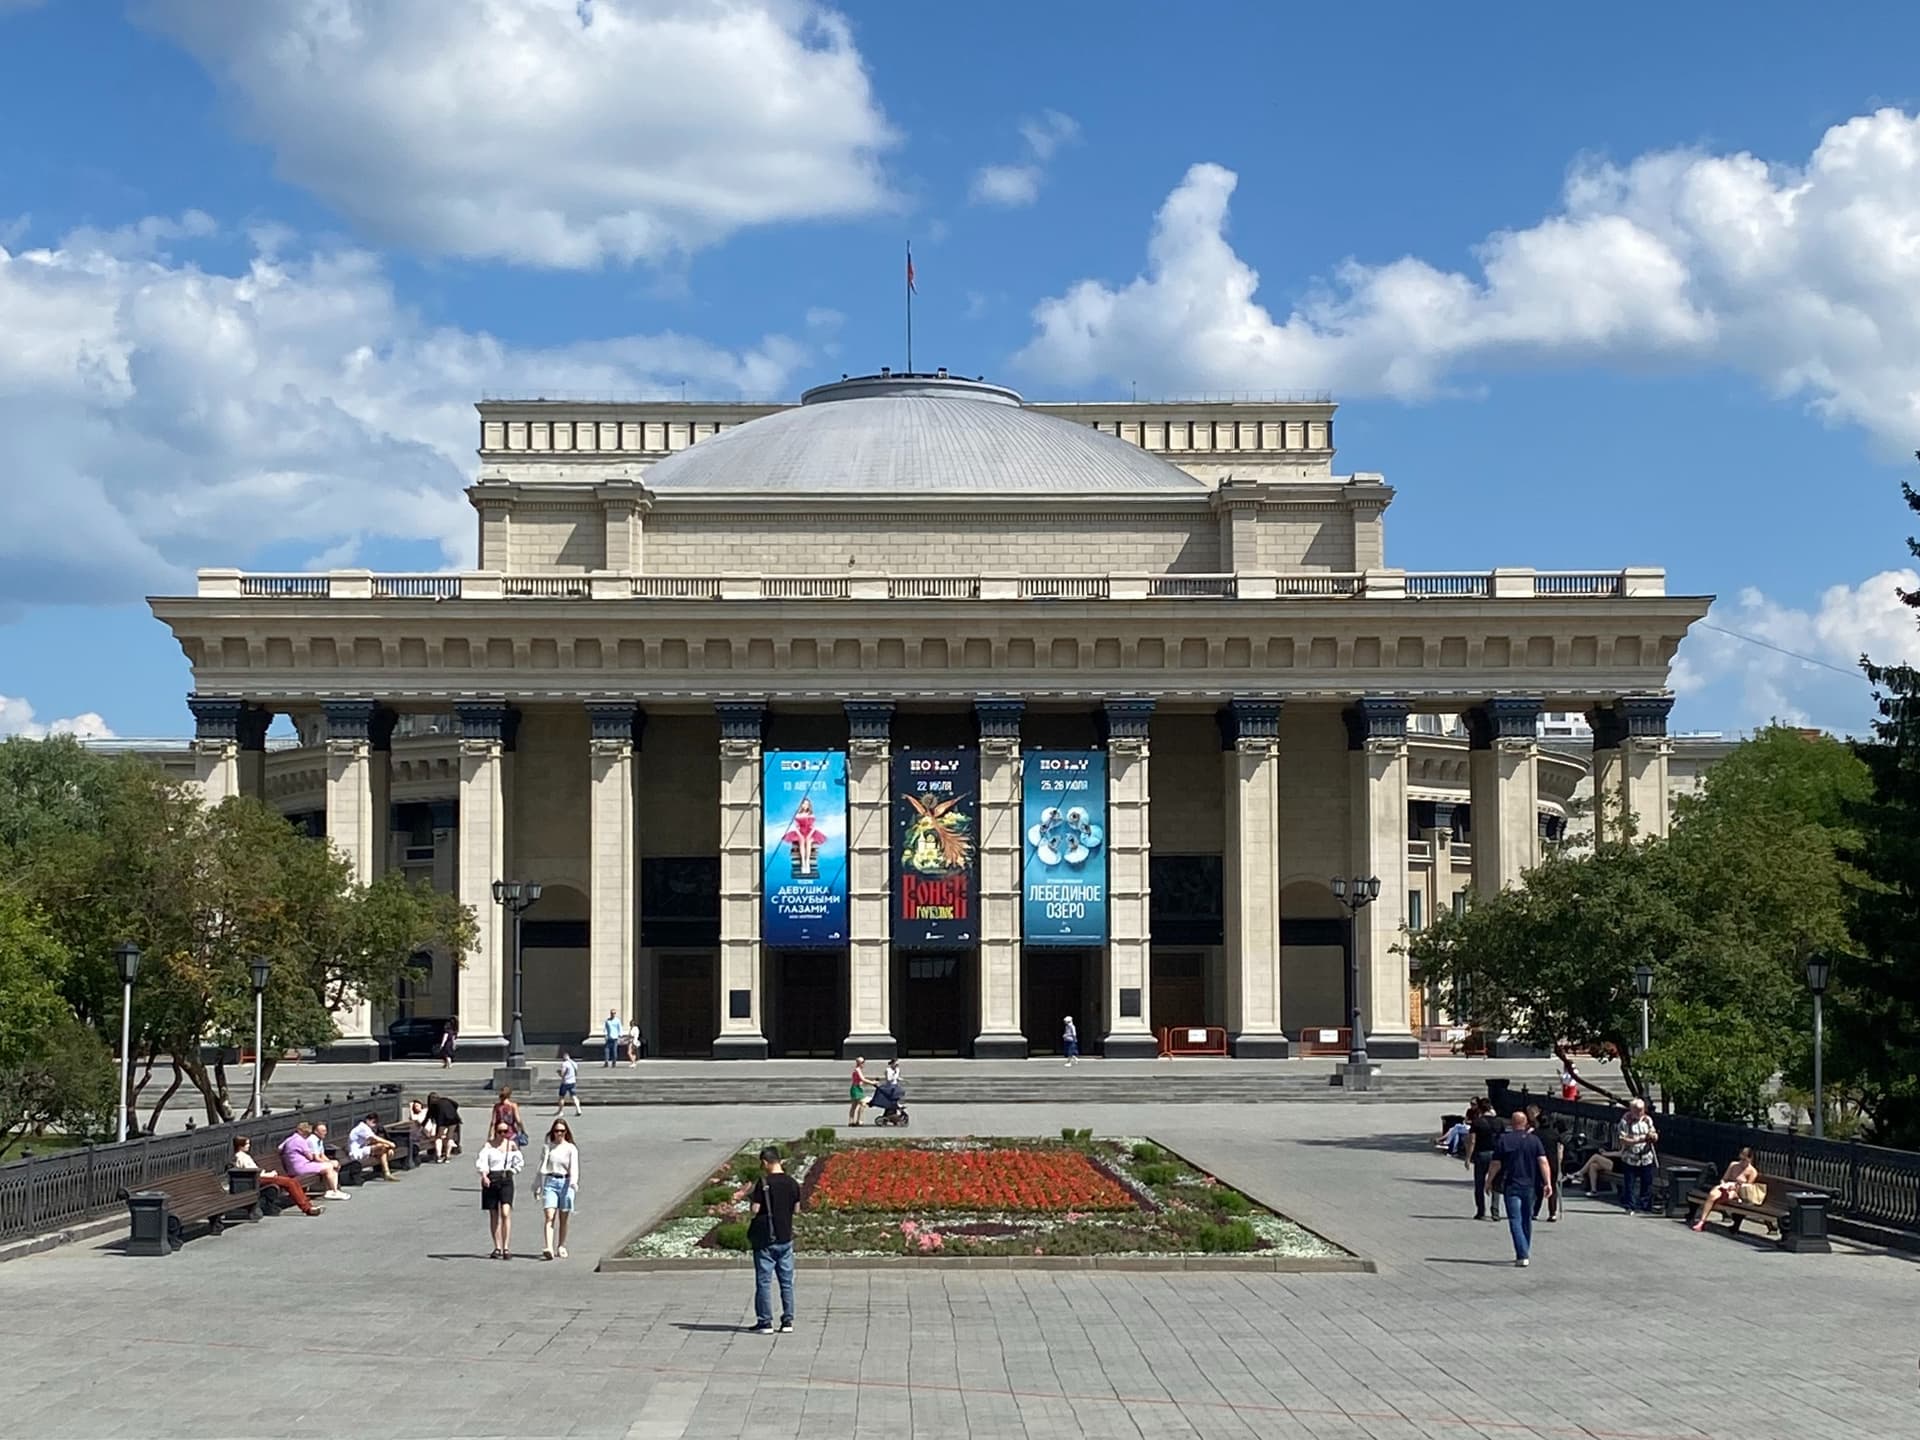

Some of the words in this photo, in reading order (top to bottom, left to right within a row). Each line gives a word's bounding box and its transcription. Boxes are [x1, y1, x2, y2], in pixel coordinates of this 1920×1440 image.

[917, 781, 927, 791] 22
[1054, 780, 1064, 790] 26
[778, 885, 830, 896] ДЕВУШКА
[1029, 885, 1101, 902] ЛЕБЕДИНОЕ
[771, 895, 779, 904] С
[781, 895, 841, 904] ГОЛУБЫМИ
[1046, 902, 1085, 918] ОЗЕРО
